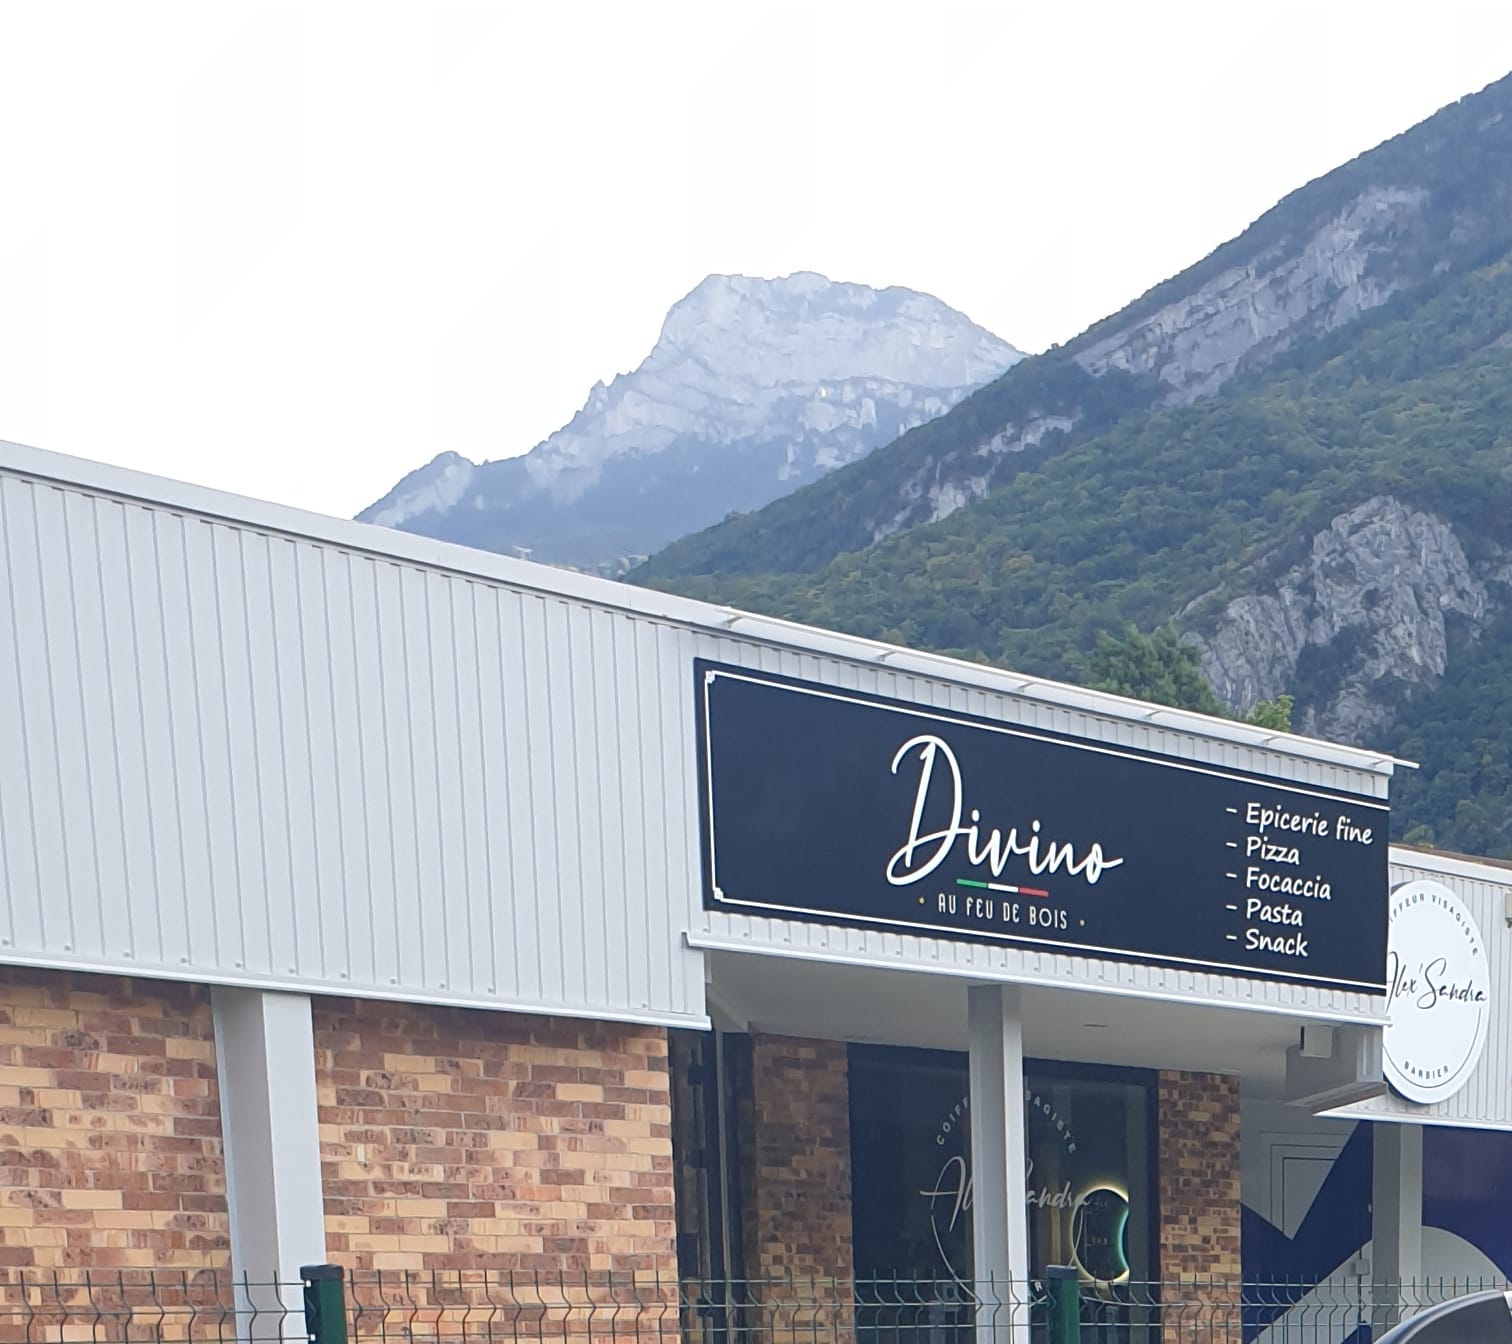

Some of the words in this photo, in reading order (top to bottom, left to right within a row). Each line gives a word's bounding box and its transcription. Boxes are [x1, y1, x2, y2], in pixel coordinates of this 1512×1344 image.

[887, 734, 1124, 886] Divino
[1245, 802, 1329, 834] Epicerie
[1336, 815, 1373, 845] fine
[1246, 836, 1300, 865] Pizza
[1246, 866, 1332, 900] Focaccia
[938, 892, 957, 915] AU
[966, 896, 994, 920] FEU
[1002, 902, 1021, 924] DE
[1029, 905, 1068, 930] BOIS
[1246, 898, 1304, 927] Pasta
[1245, 928, 1309, 957] Snack
